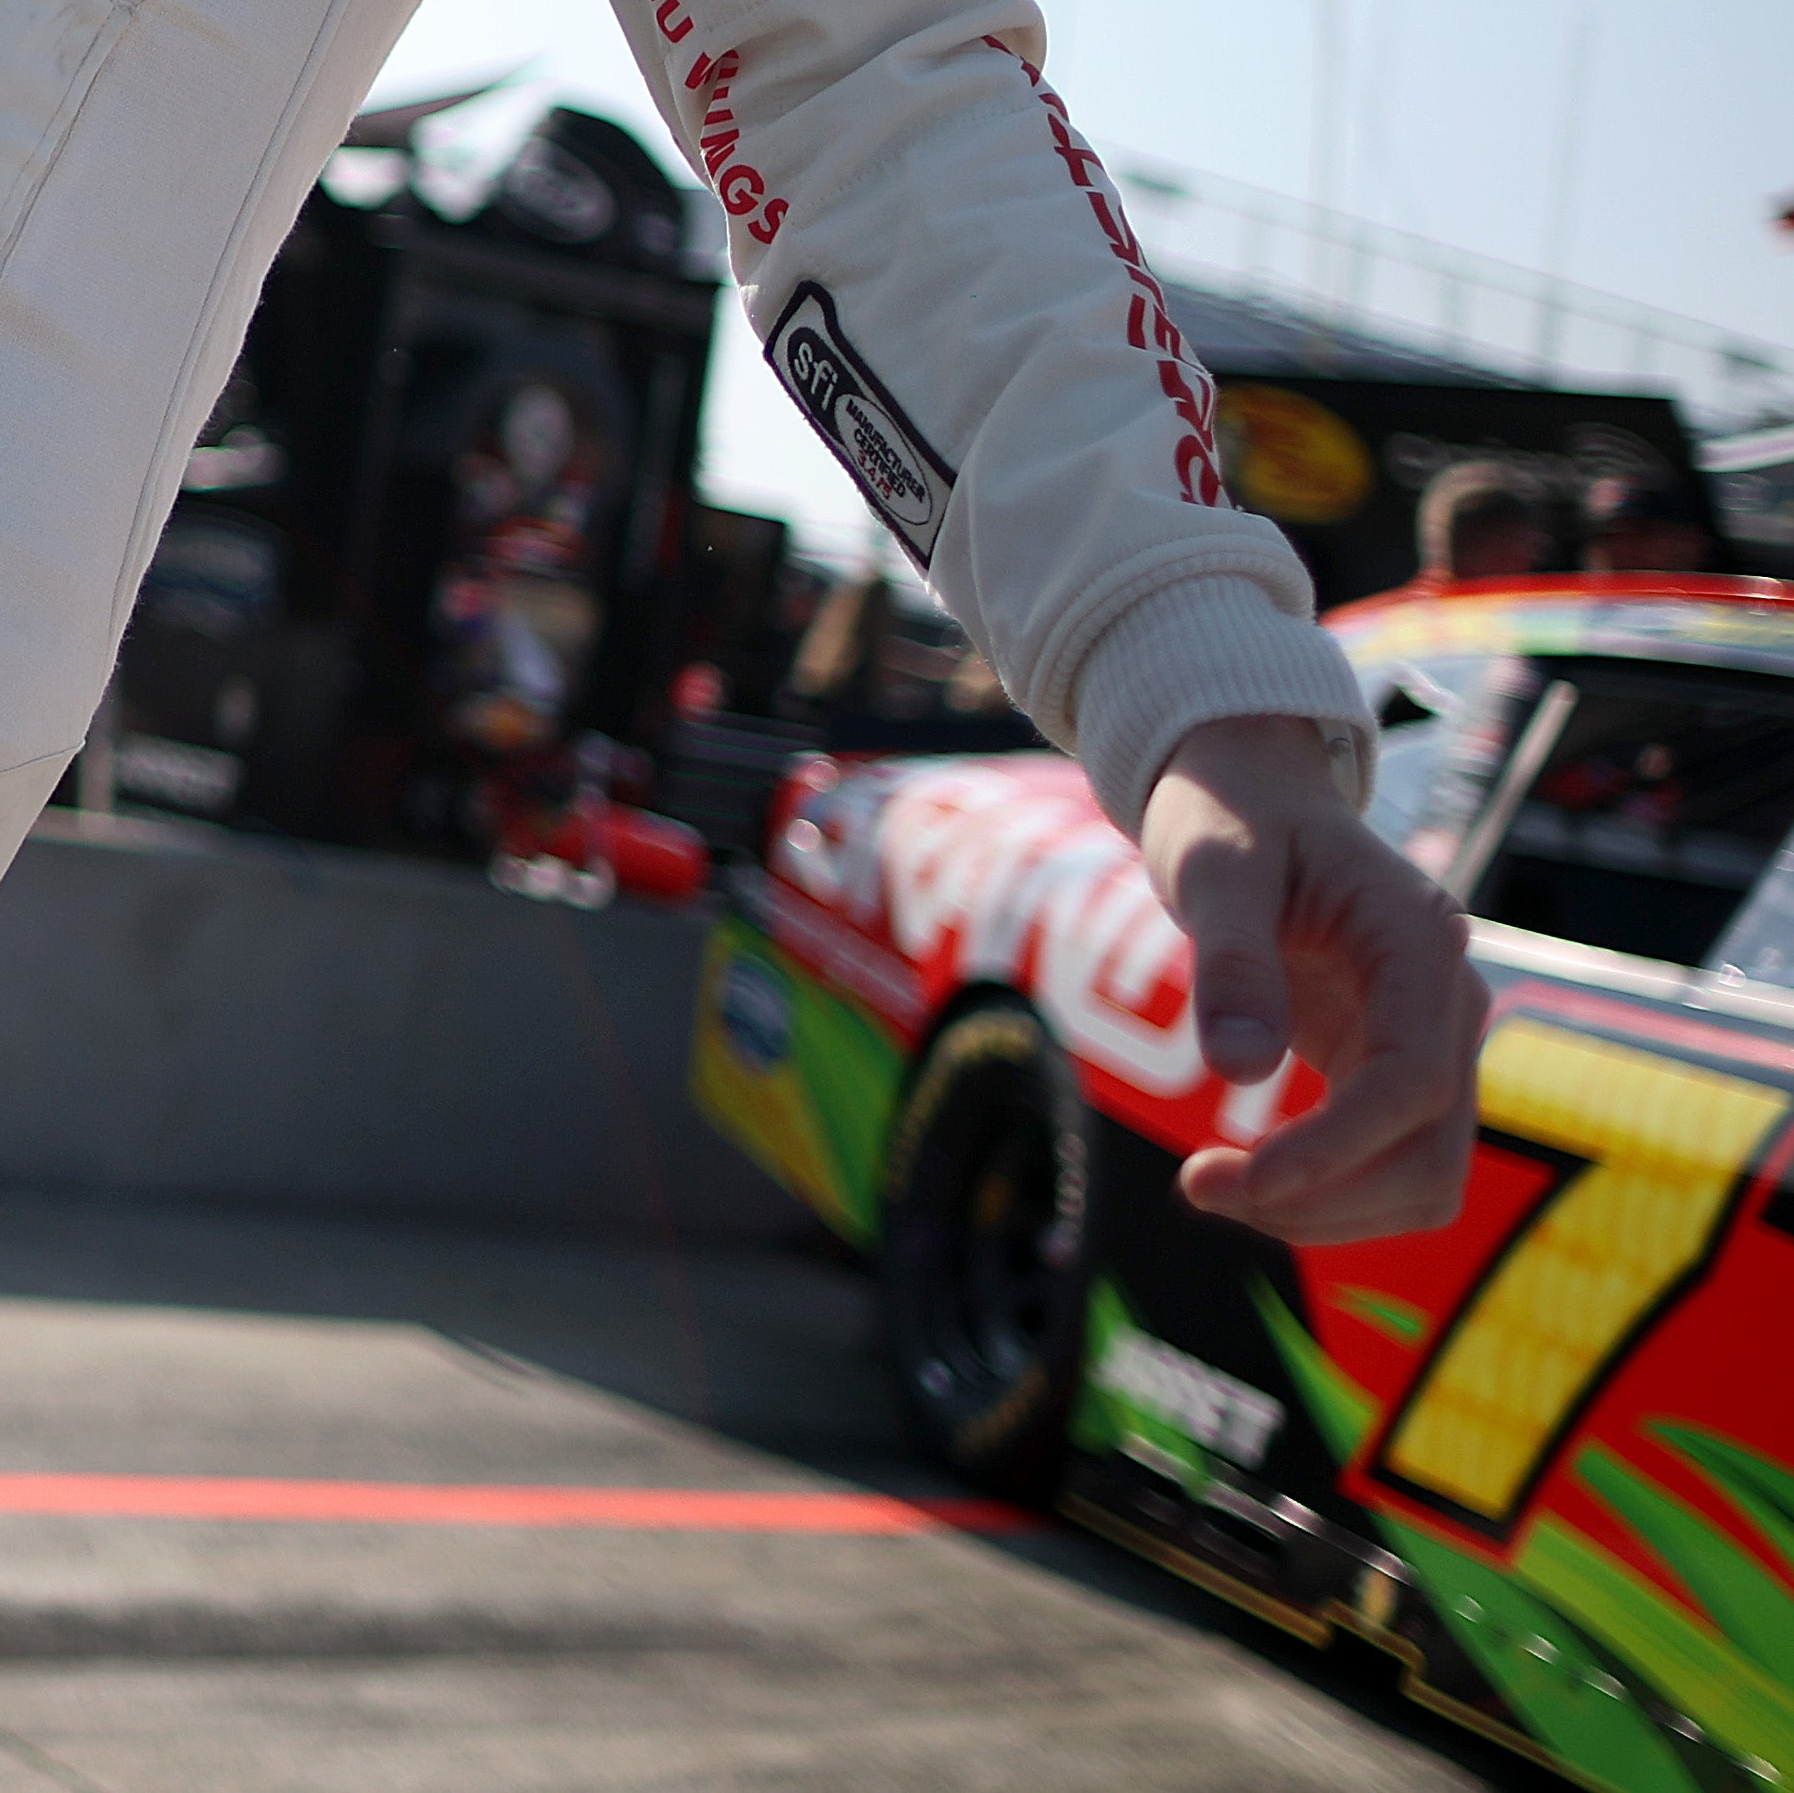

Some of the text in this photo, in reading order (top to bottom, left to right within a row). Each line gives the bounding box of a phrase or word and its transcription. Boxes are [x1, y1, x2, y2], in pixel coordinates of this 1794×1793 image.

[794, 341, 840, 412] sfi
[845, 398, 927, 504] MANUFACTURER
[853, 427, 906, 499] CERTIFIED
[1383, 1011, 1794, 1526] 7
